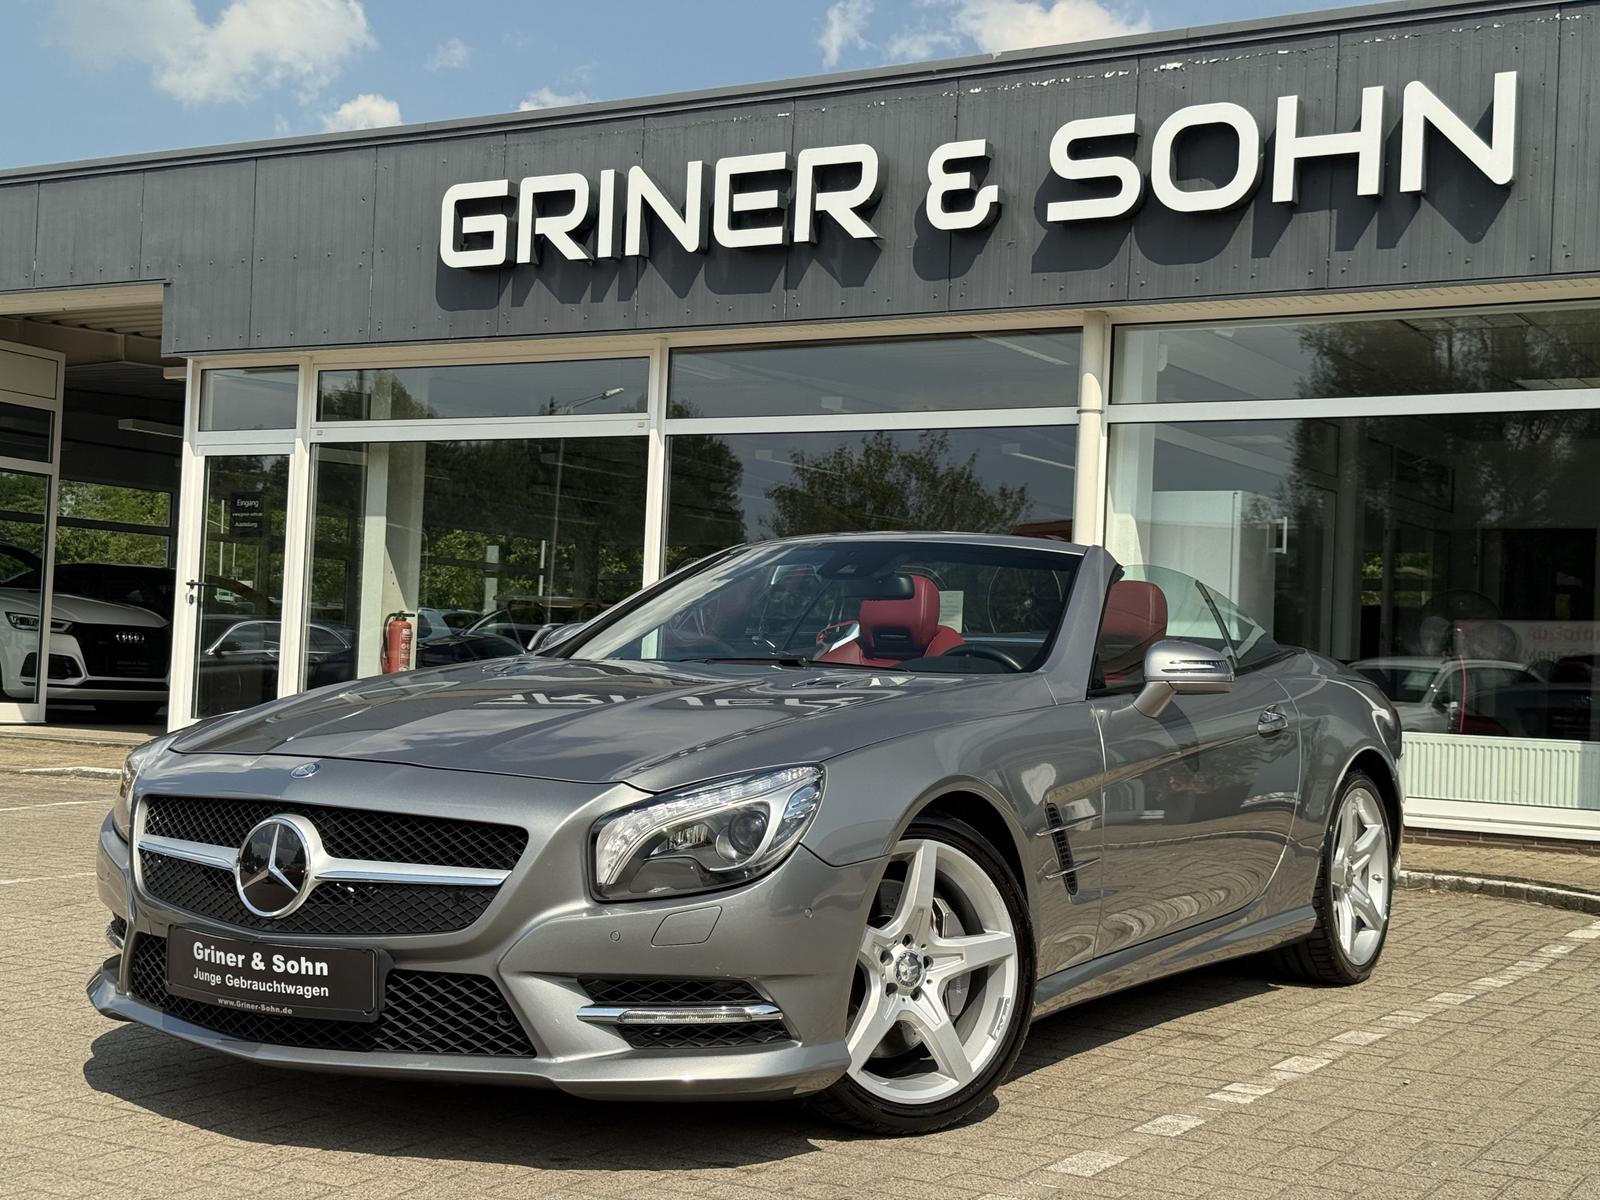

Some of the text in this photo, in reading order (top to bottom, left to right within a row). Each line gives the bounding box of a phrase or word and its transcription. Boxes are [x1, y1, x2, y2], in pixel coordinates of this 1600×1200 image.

[440, 71, 1517, 269] GRINER & SOHN
[193, 941, 329, 976] Griner & Sohn
[193, 967, 329, 998] Junge Gebrauchtwagen
[217, 997, 293, 1015] www.Griner-Sohn.de
